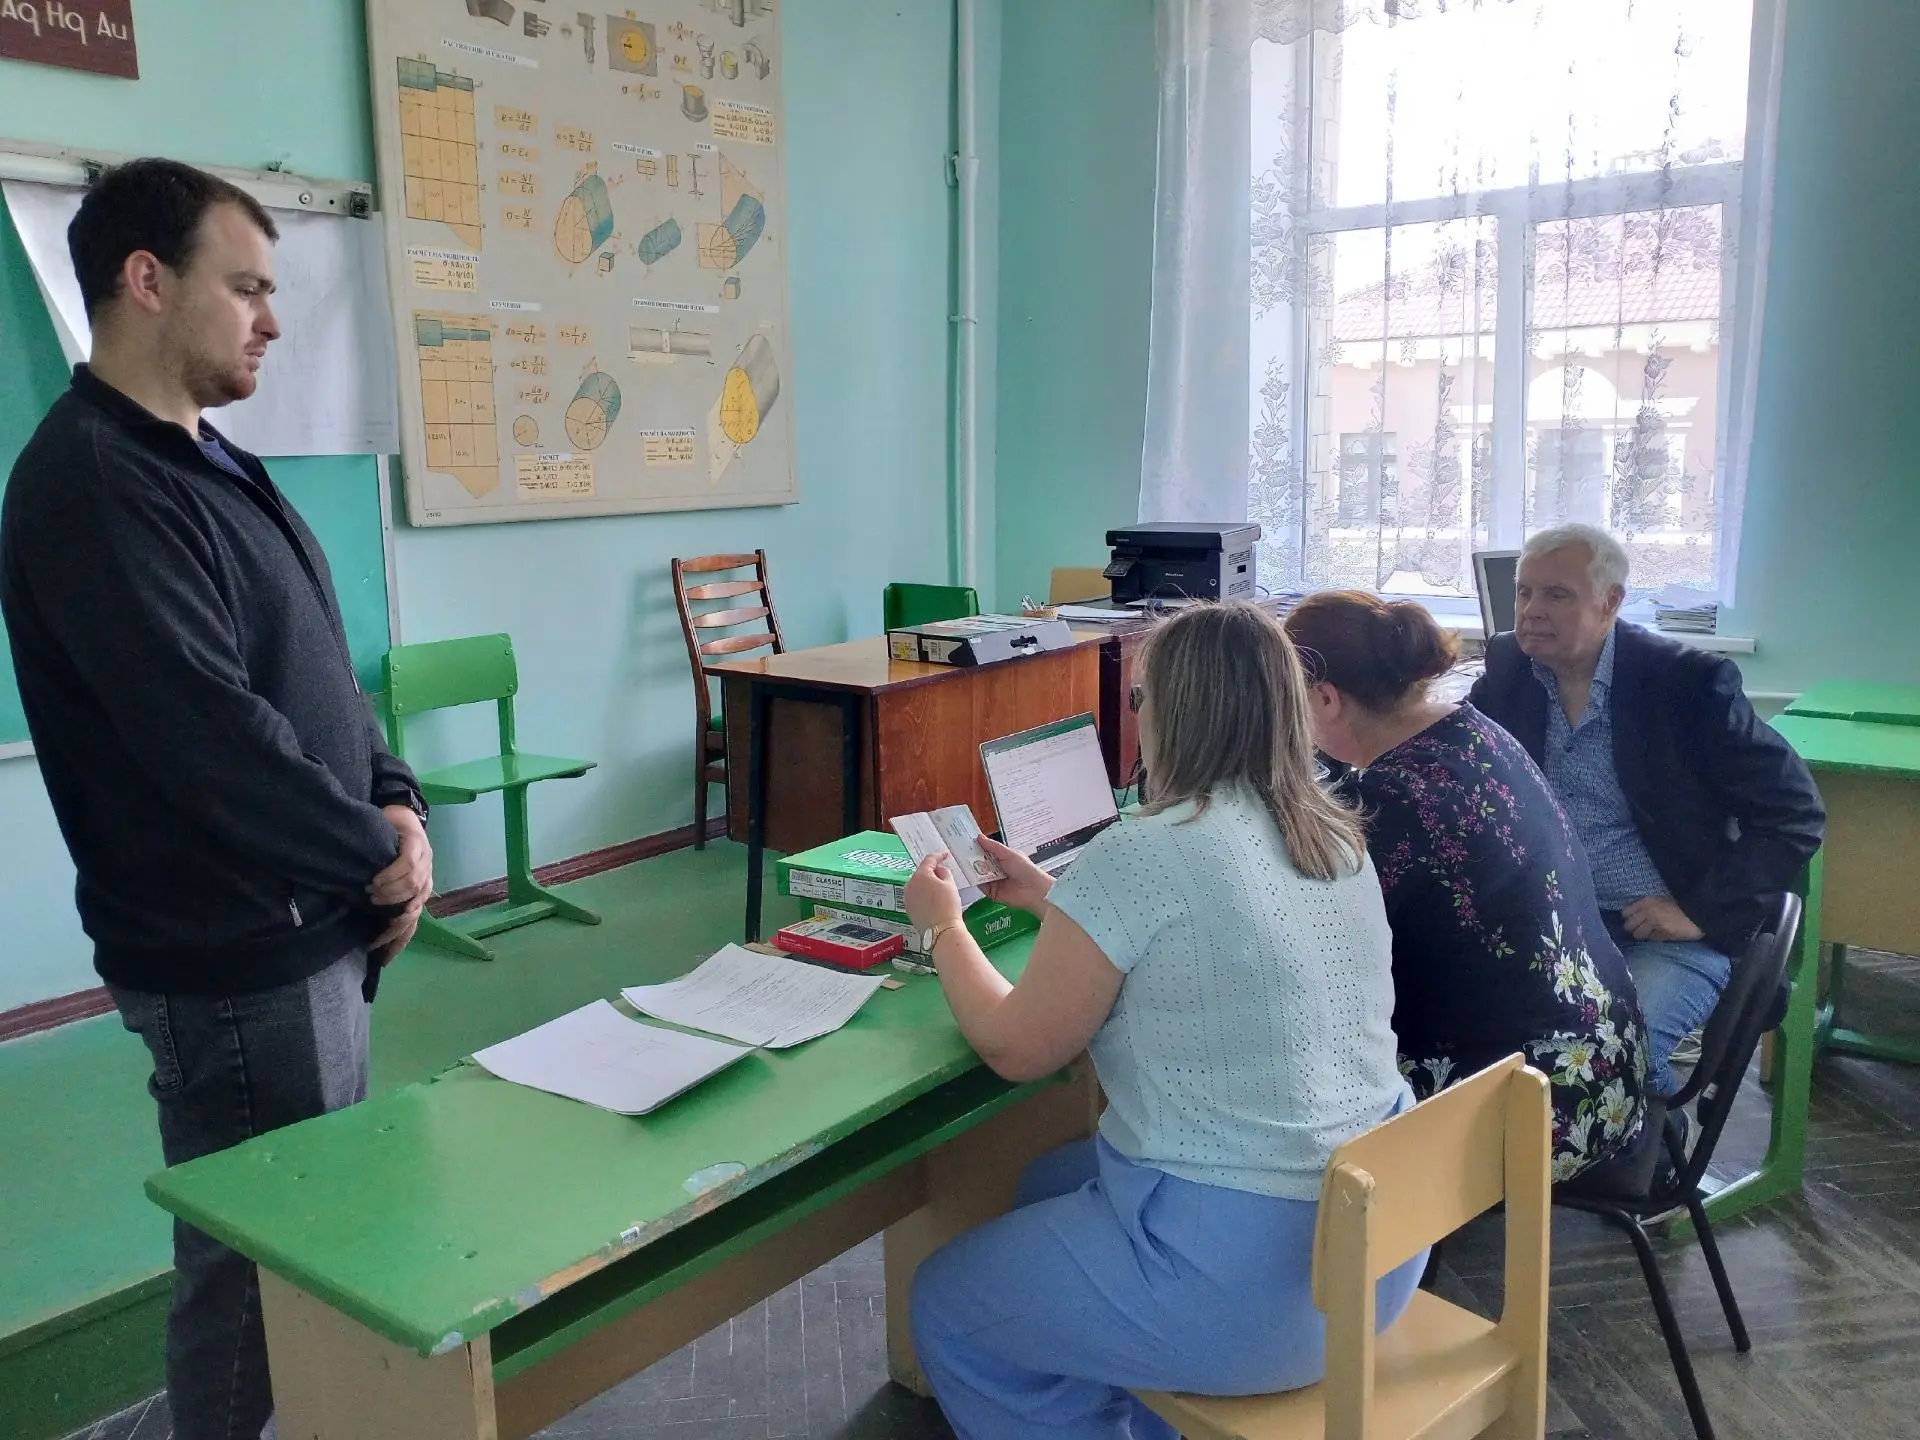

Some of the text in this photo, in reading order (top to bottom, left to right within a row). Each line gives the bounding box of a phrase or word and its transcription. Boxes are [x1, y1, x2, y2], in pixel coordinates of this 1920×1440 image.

[97, 11, 128, 41] Au
[815, 876, 842, 886] CLASSIC
[841, 914, 868, 925] CLASSIC
